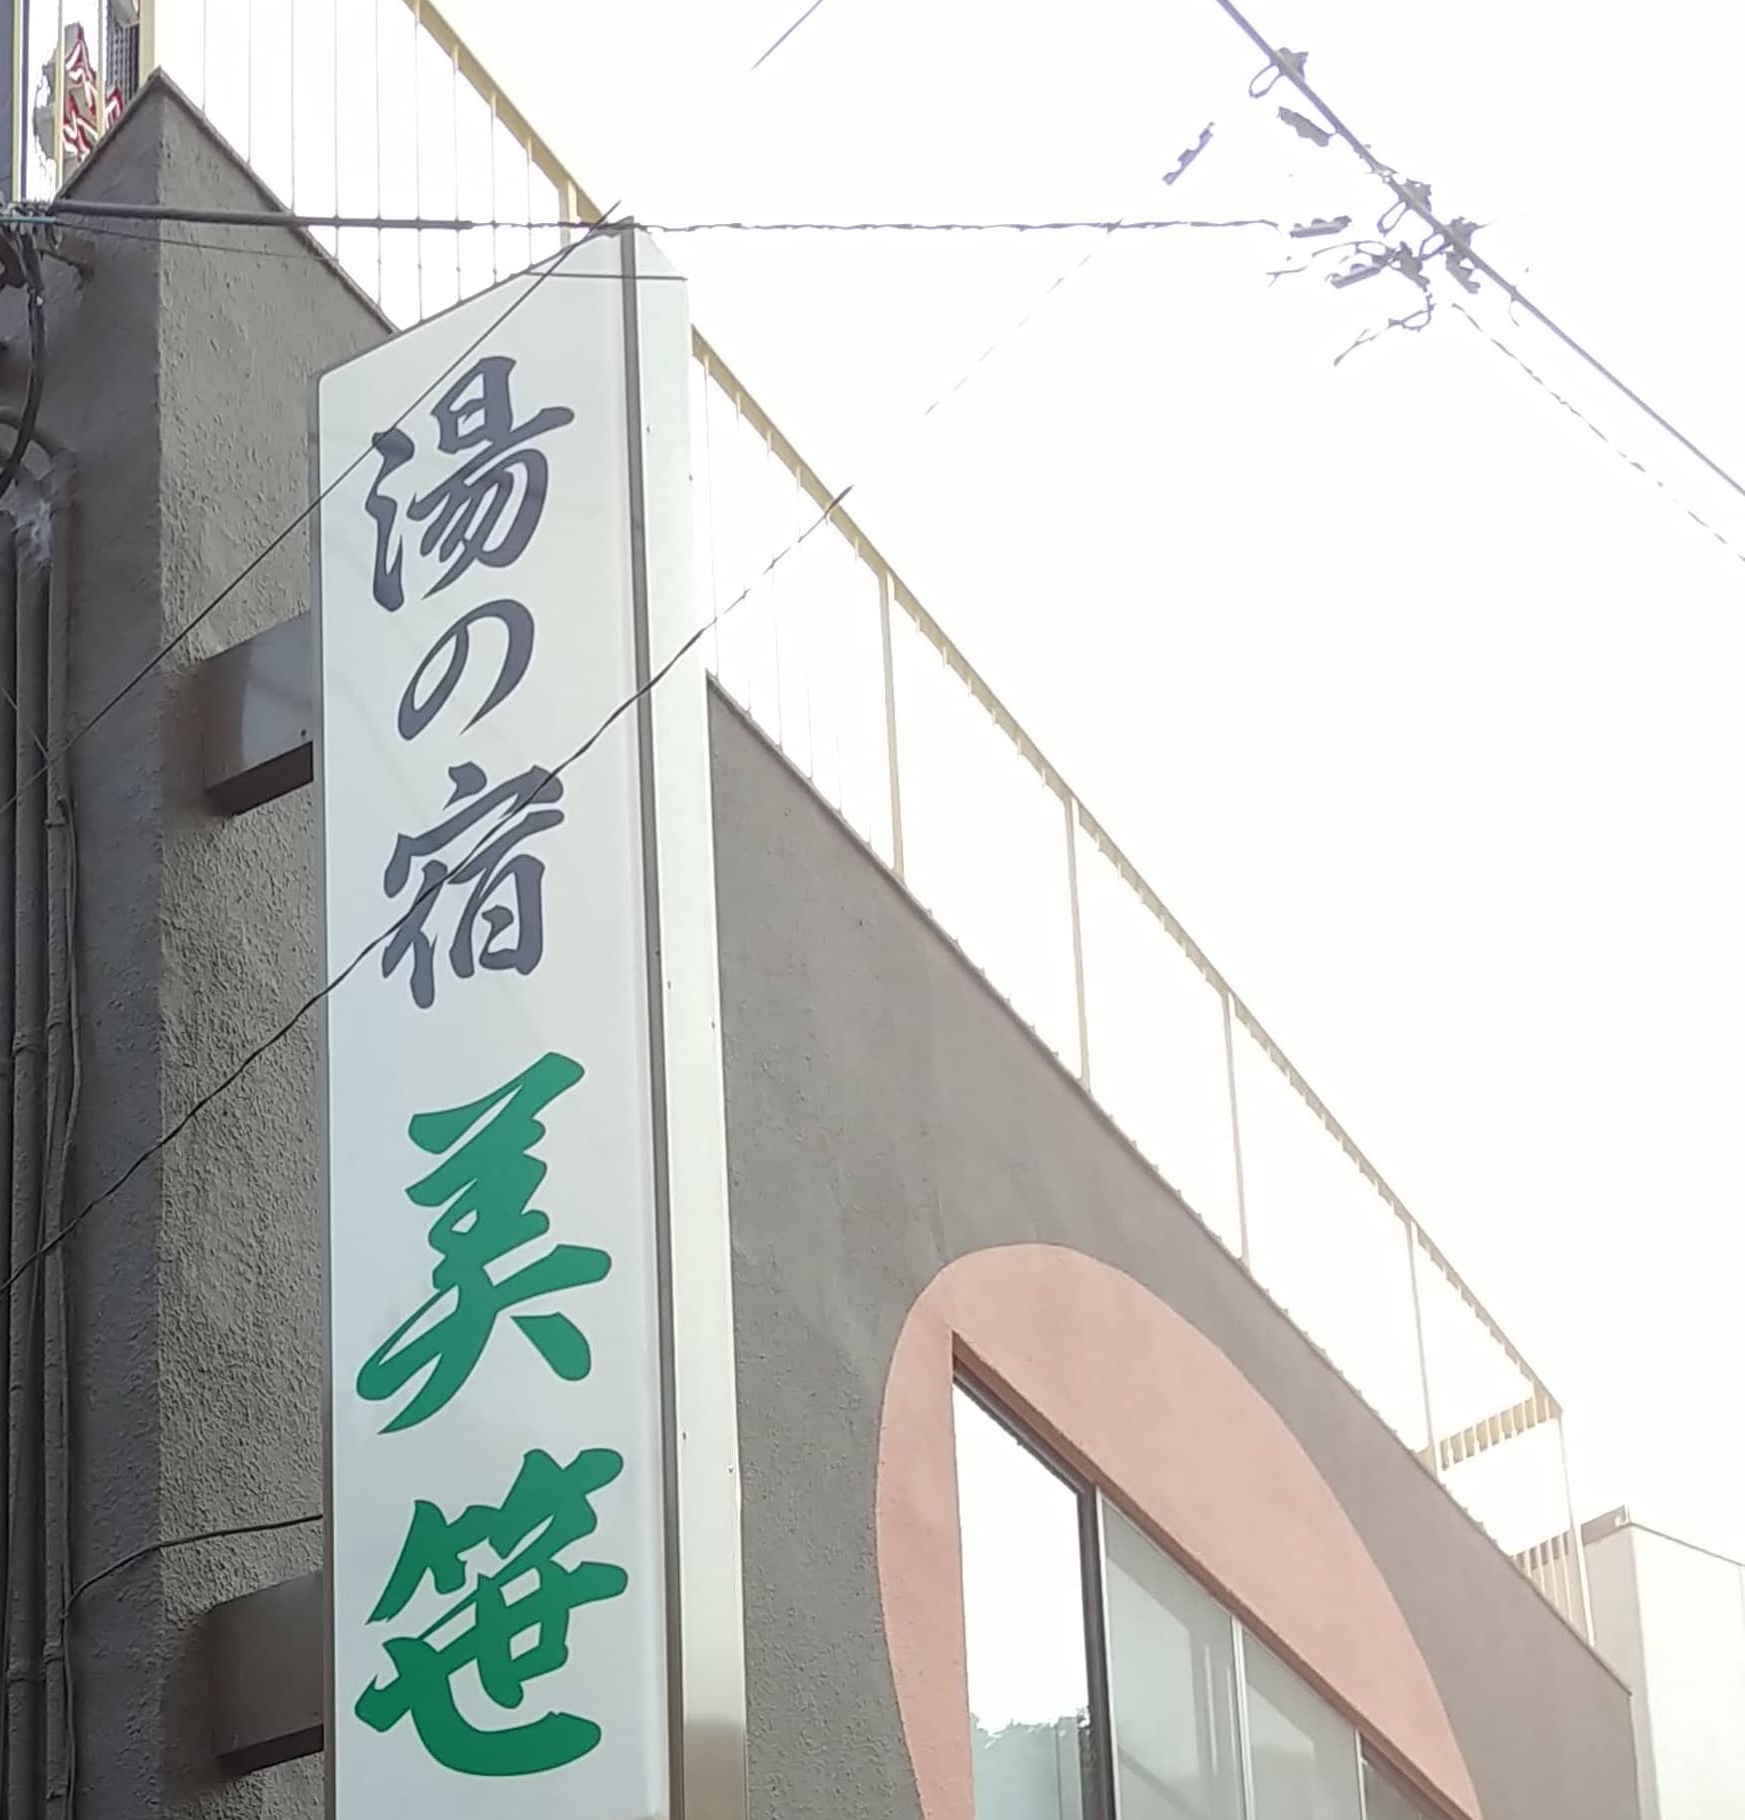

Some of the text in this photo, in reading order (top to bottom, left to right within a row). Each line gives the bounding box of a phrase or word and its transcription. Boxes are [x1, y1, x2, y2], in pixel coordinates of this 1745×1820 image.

[355, 356, 628, 1777] 湯の宿 美笹
